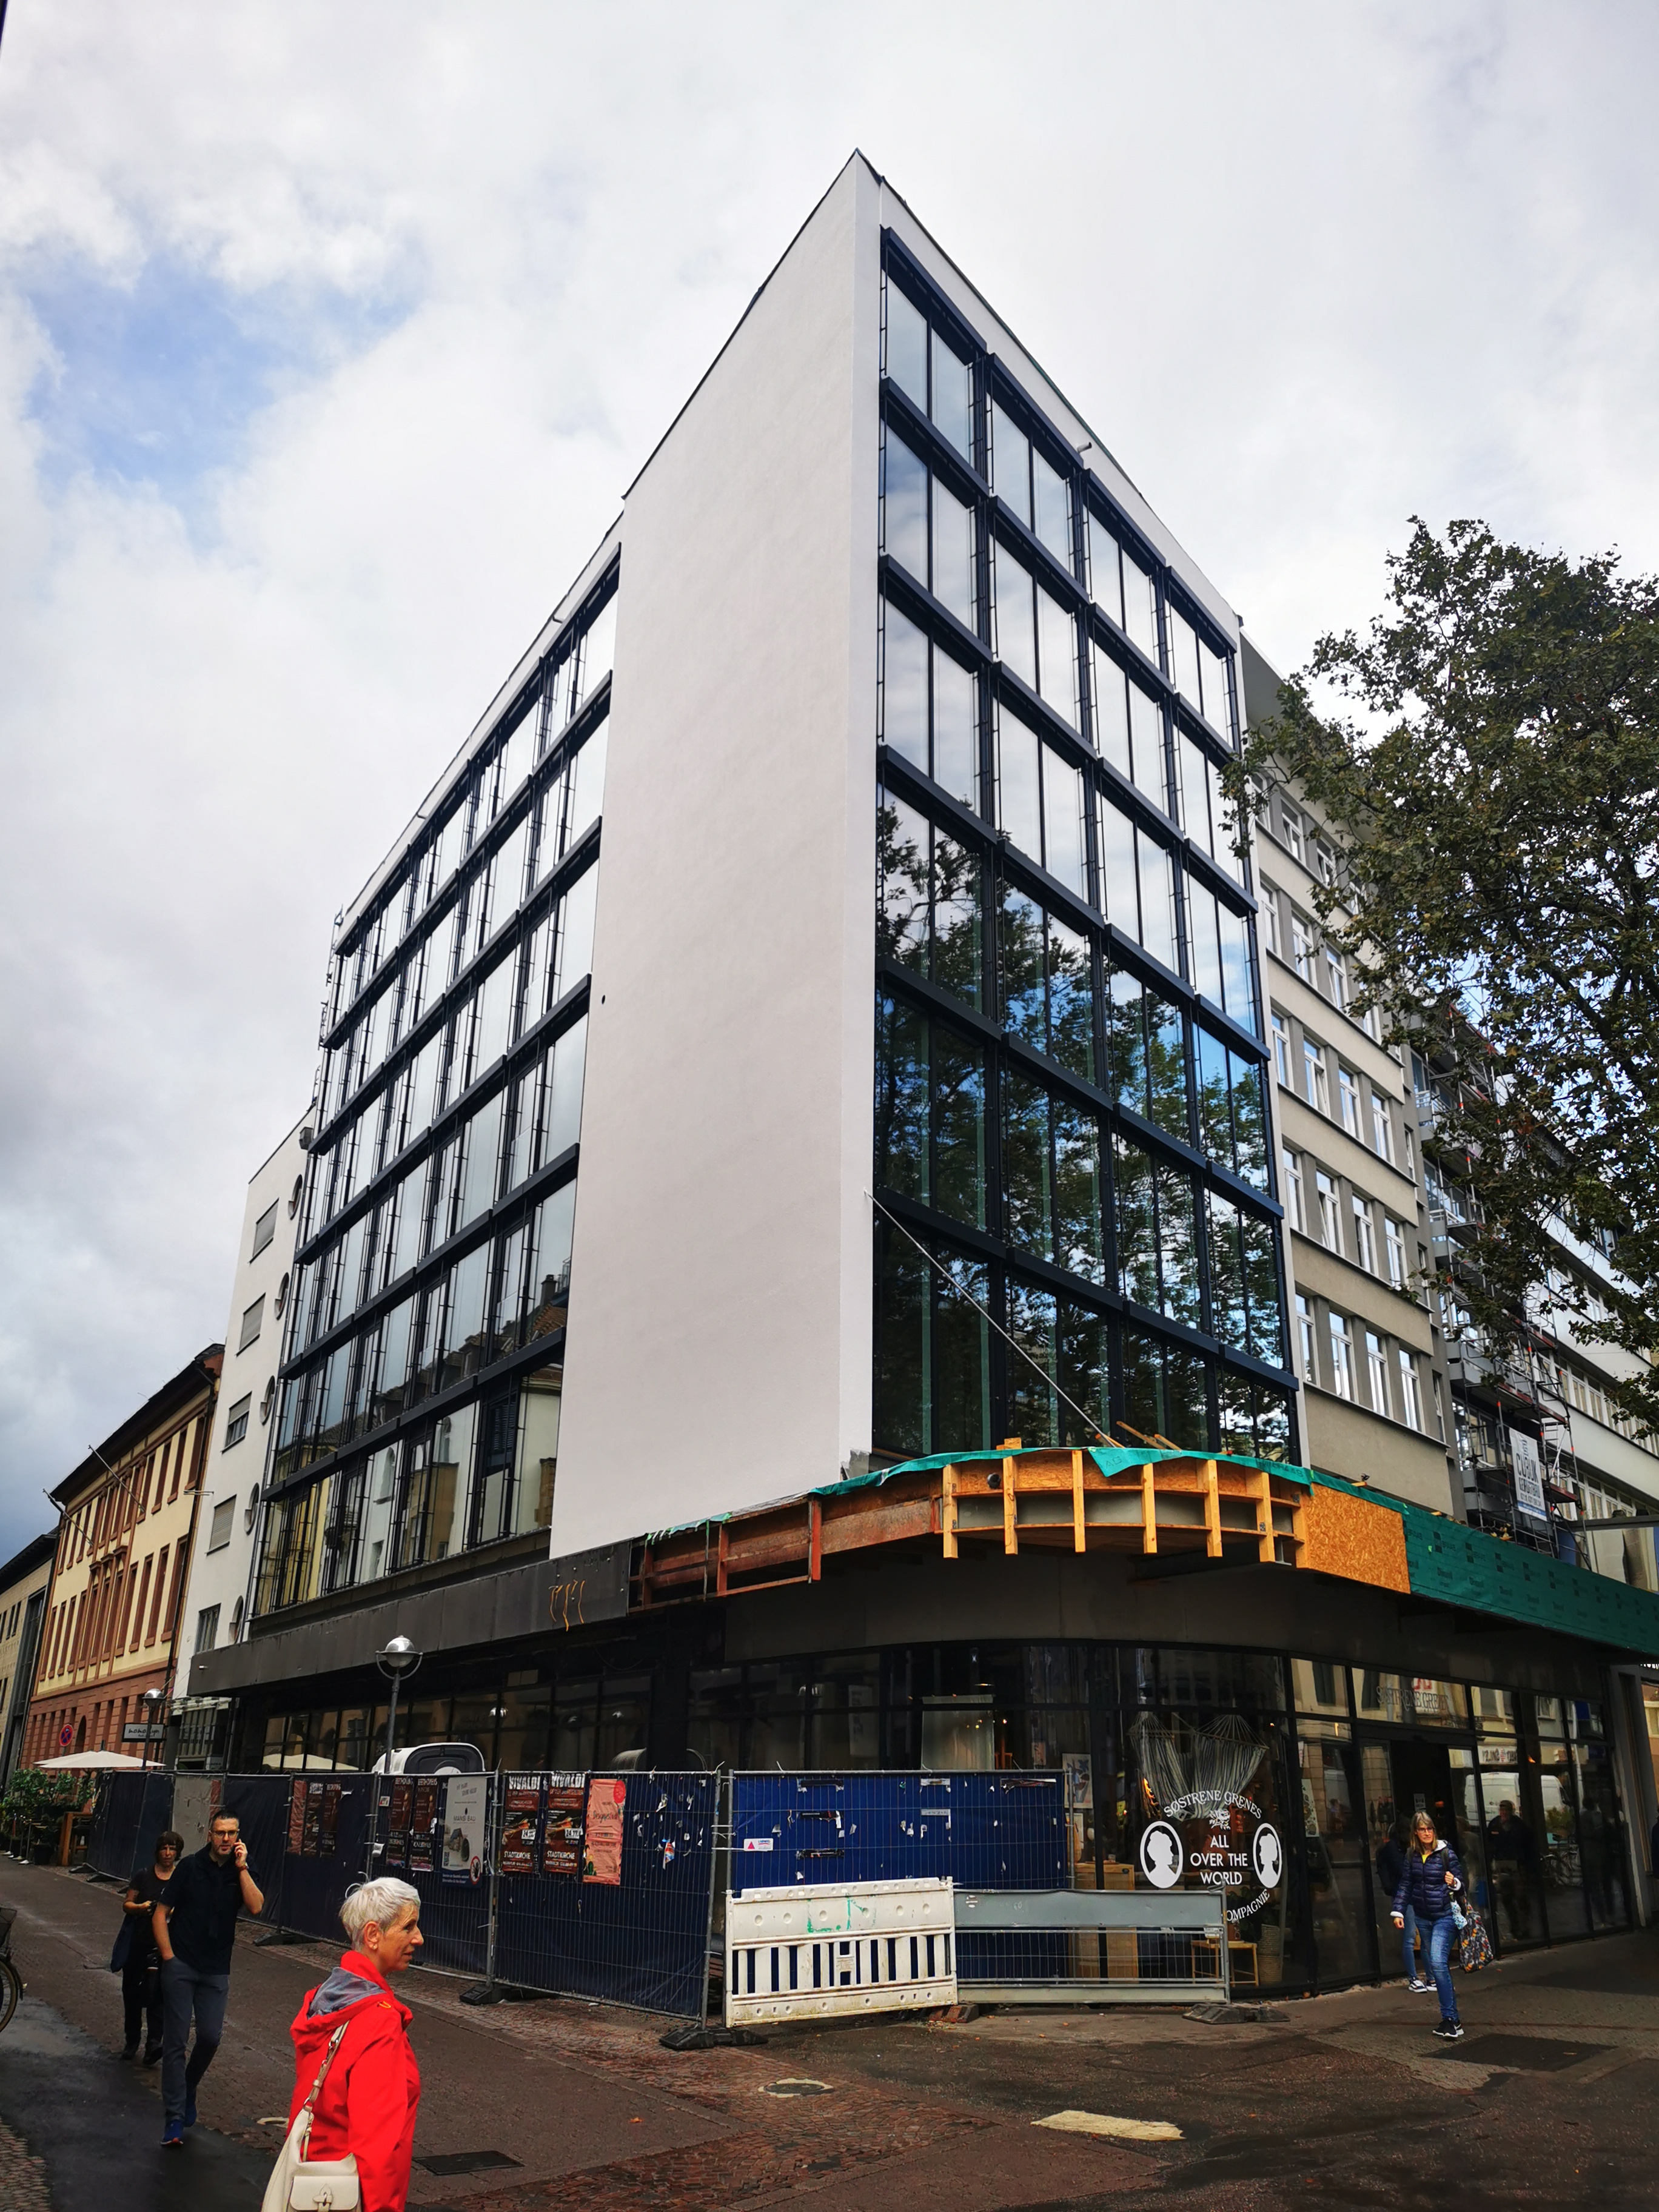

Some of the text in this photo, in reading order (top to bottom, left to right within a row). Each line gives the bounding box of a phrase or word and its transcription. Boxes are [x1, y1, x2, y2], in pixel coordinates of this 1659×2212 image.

[509, 1775, 541, 1790] VIVALDI
[551, 1774, 586, 1788] VIVALDI
[1164, 1790, 1262, 1819] SØSTRENE GRENES
[1210, 1835, 1229, 1848] ALL
[504, 1851, 531, 1860] STADTKIRCHE
[547, 1850, 575, 1859] STADTKIRCHE
[1190, 1852, 1248, 1866] OVER THE
[1200, 1871, 1242, 1885] WORLD
[1226, 1889, 1270, 1922] OMPAGNIE
